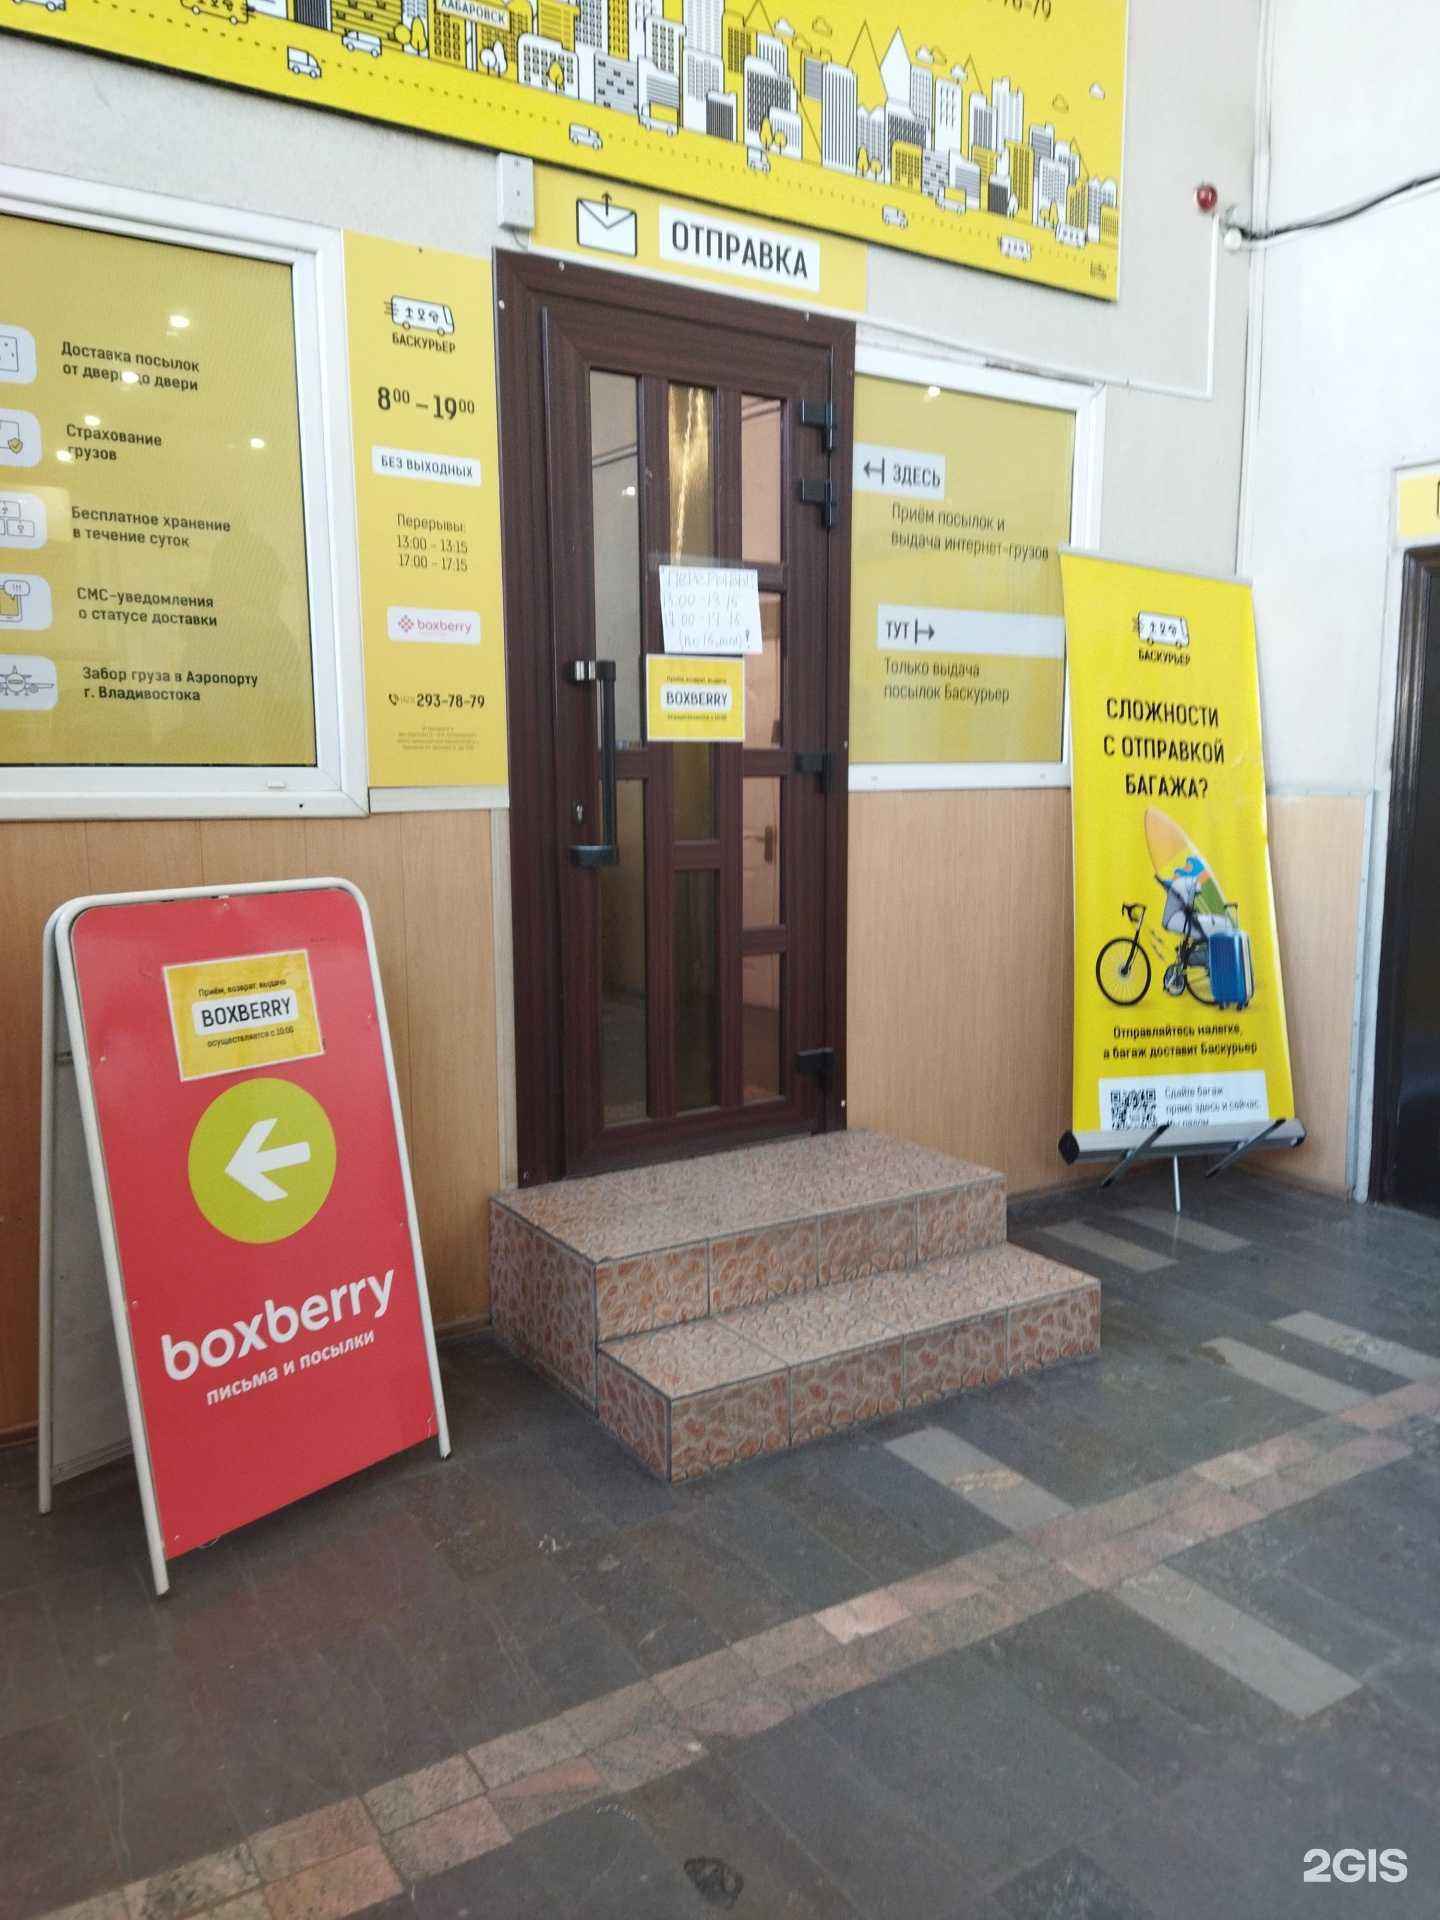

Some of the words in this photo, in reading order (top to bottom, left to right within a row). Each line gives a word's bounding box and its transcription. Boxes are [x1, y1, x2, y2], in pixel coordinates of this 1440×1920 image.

[672, 220, 808, 280] ОТПРАВКА
[392, 332, 456, 354] БАСКУРЬЕР
[61, 341, 132, 364] Доставка
[135, 353, 200, 373] посылок
[62, 363, 78, 376] от
[154, 375, 199, 392] двери
[66, 424, 163, 447] Страхование
[381, 454, 404, 470] БЕЗ
[406, 458, 474, 479] ВЫХОДНЫХ
[893, 463, 941, 488] ЗДЕСЬ
[71, 506, 159, 526] Бесплатное
[163, 516, 231, 533] хранение
[938, 511, 994, 531] посылок
[997, 519, 1006, 531] и
[72, 527, 81, 539] в
[85, 529, 146, 544] течение
[149, 534, 190, 548] суток
[891, 532, 941, 551] выдача
[76, 587, 214, 608] СМС-уведомления
[78, 610, 87, 620] о
[91, 609, 148, 624] статусе
[151, 613, 218, 627] доставки
[416, 618, 472, 635] boxberry
[886, 620, 910, 640] ТУТ
[885, 657, 930, 676] Только
[933, 664, 980, 678] выдача
[1138, 650, 1191, 667] БАСКУРЬЕР
[82, 667, 127, 682] Забор
[131, 668, 171, 684] груза
[174, 673, 182, 683] в
[186, 670, 259, 688] Аэропорту
[83, 687, 95, 699] г.
[98, 686, 201, 702] Владивостока
[416, 692, 486, 709] 293-78-79
[666, 690, 728, 707] BOXBERRY
[884, 683, 941, 699] посылок
[944, 684, 1010, 706] Баскурьер
[1106, 697, 1219, 728] СЛОЖНОСТИ
[1103, 734, 1115, 757] С
[1121, 735, 1225, 764] ОТПРАВКОЙ
[1125, 773, 1209, 799] БАГАЖА?
[201, 996, 291, 1028] BOXBERRY
[1113, 1024, 1195, 1040] Отправляйтесь
[1112, 1046, 1146, 1059] багаж
[160, 1268, 394, 1381] boxberry
[206, 1366, 279, 1406] письма
[282, 1359, 296, 1377] и
[299, 1329, 376, 1371] посылки
